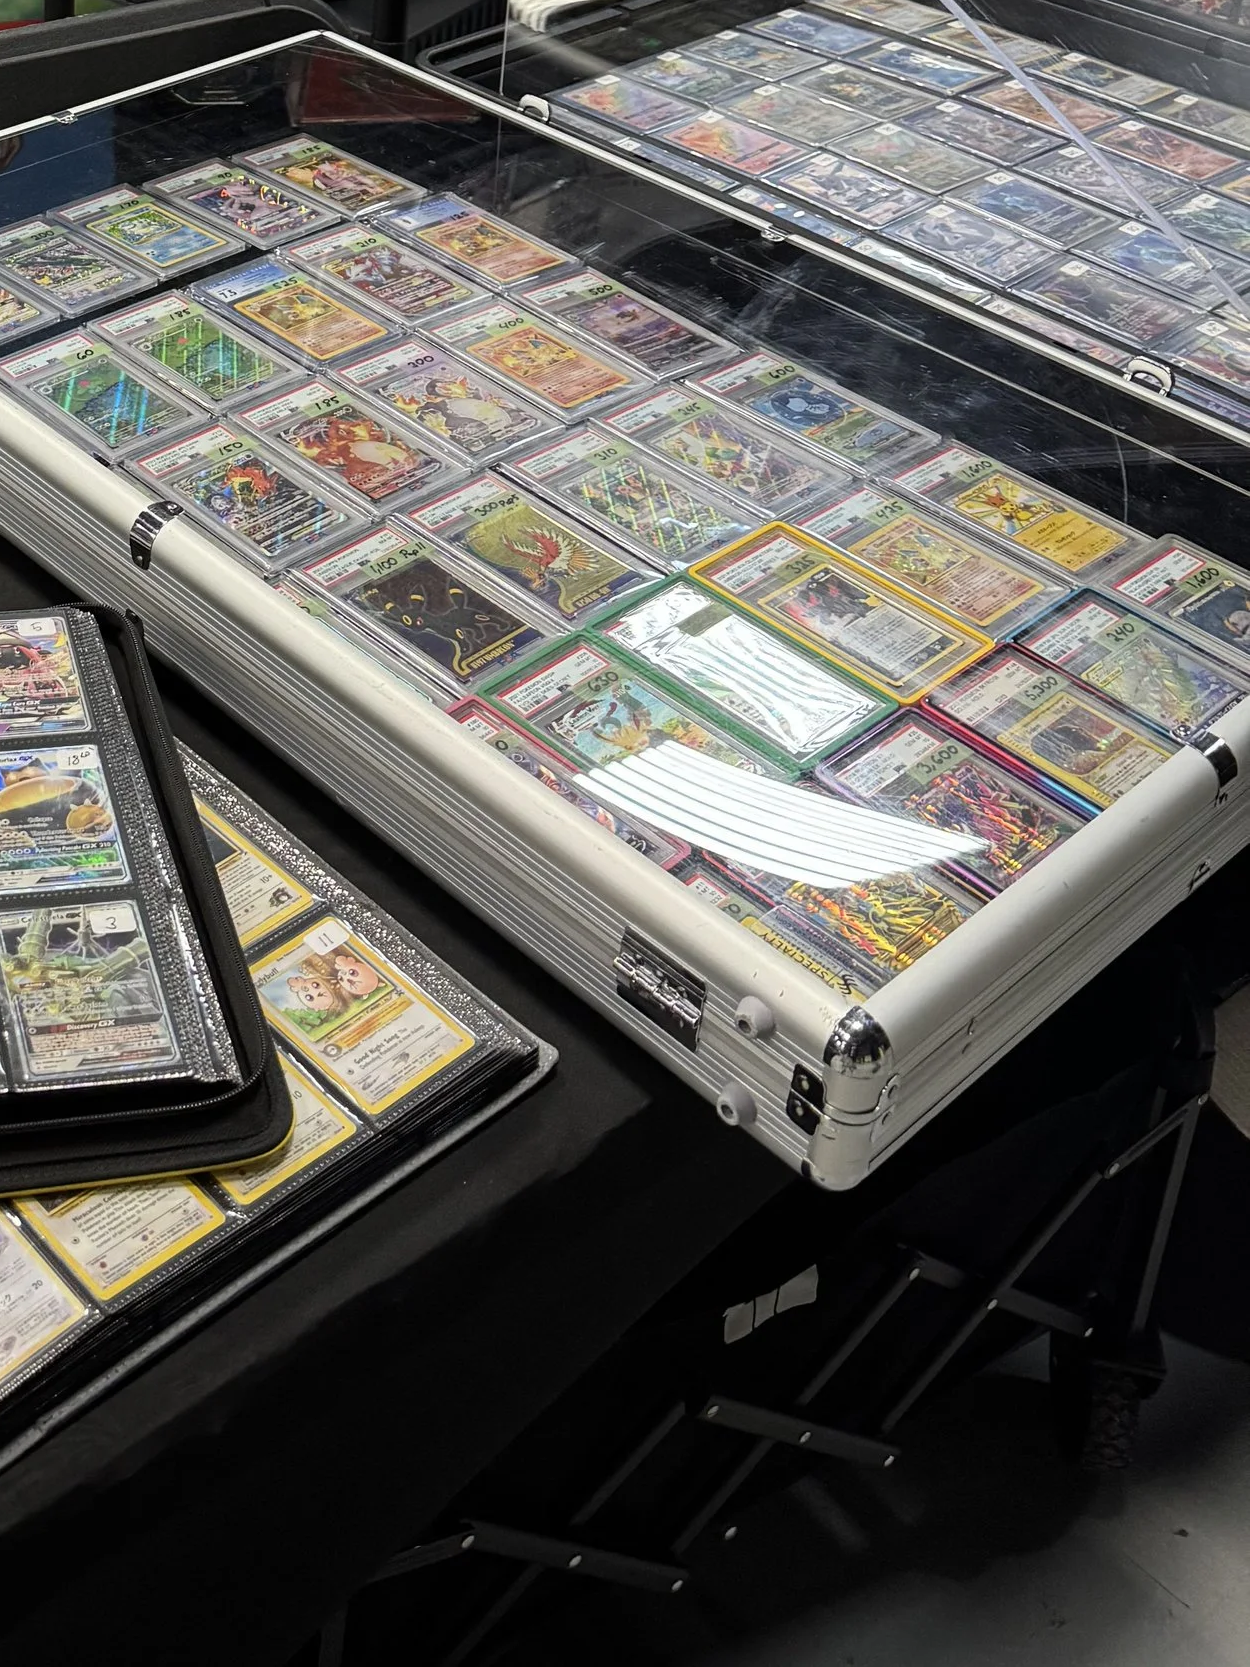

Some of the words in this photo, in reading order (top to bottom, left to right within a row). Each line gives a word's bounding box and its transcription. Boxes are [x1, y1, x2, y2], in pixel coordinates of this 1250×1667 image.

[588, 283, 613, 296] 500
[170, 308, 191, 321] 185
[498, 317, 524, 329] 400
[76, 348, 95, 361] 60
[768, 365, 796, 380] 600
[314, 395, 340, 412] 185
[961, 459, 993, 479] 1,600
[474, 504, 499, 518] 300
[369, 556, 398, 576] 1,100
[1190, 566, 1221, 590] 1,600
[587, 670, 619, 693] 630
[26, 699, 41, 707] GX
[915, 744, 960, 775] 3,600
[82, 842, 98, 851] GX
[105, 916, 117, 930] 3
[66, 1022, 99, 1031] Discovery
[99, 1019, 116, 1027] GX
[31, 1278, 45, 1291] 20
